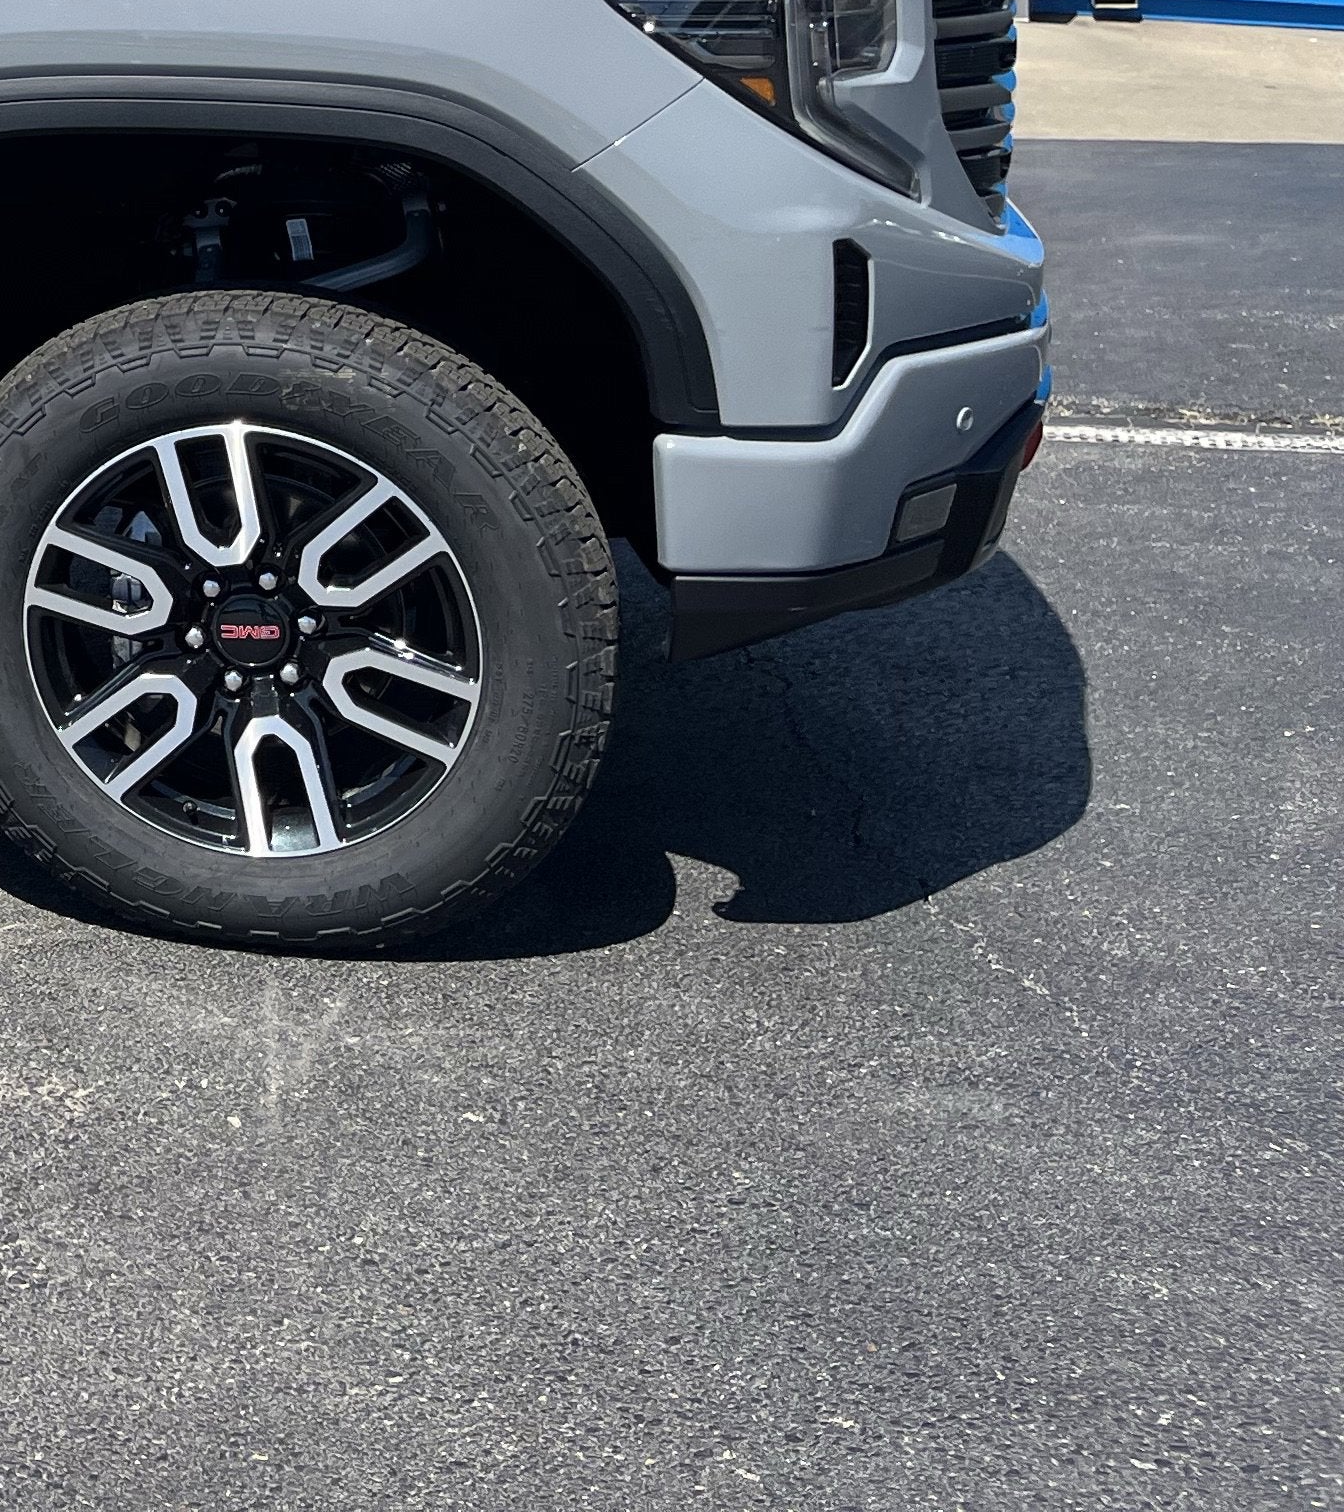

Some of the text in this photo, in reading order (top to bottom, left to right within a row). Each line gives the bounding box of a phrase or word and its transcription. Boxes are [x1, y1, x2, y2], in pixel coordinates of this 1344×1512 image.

[78, 371, 502, 536] GOODYEAR
[220, 624, 280, 639] GMC
[8, 756, 415, 921] WRANGLER
